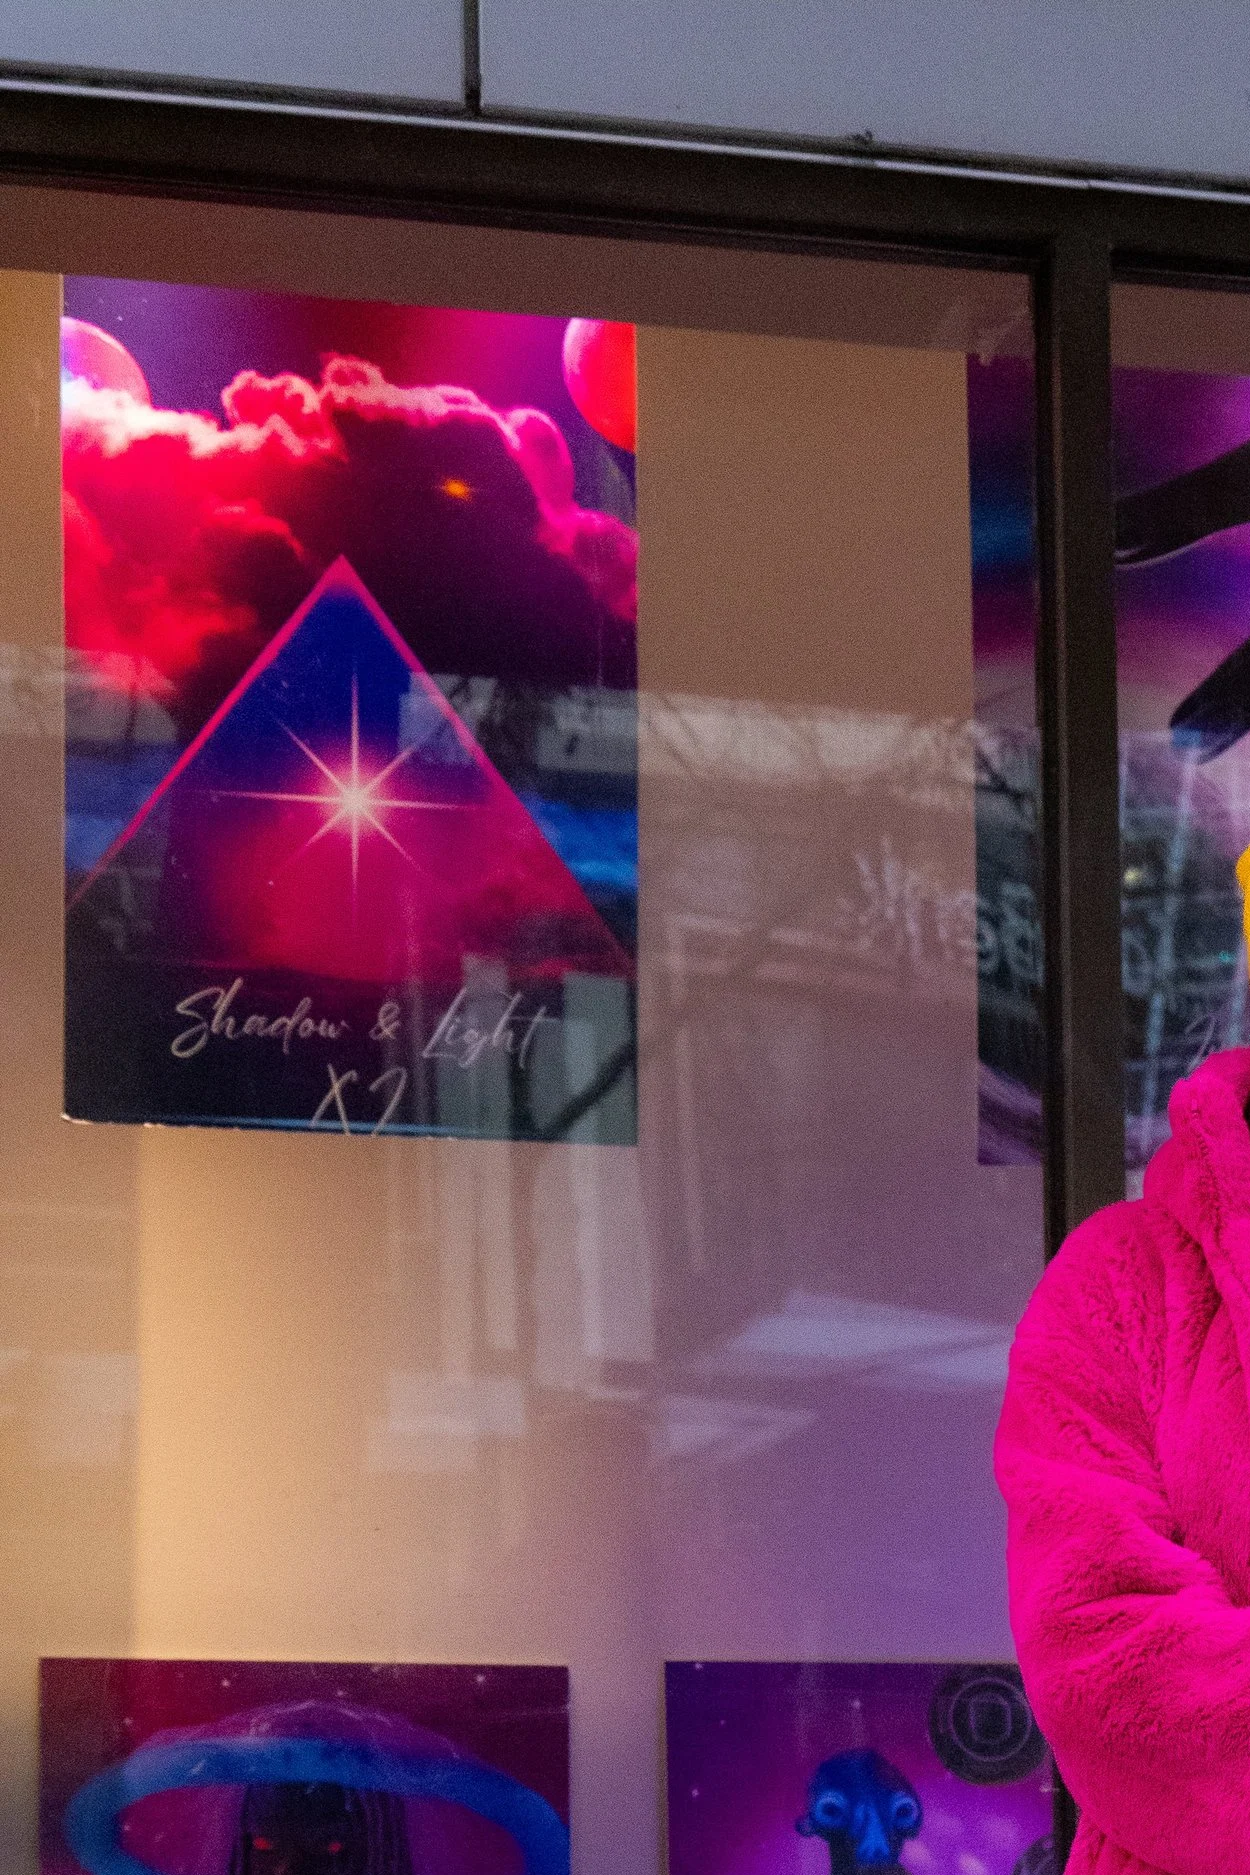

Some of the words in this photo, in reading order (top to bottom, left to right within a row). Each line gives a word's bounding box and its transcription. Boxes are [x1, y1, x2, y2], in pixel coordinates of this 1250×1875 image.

[170, 976, 346, 1059] Shadow
[370, 1001, 401, 1041] &
[423, 987, 548, 1070] Light
